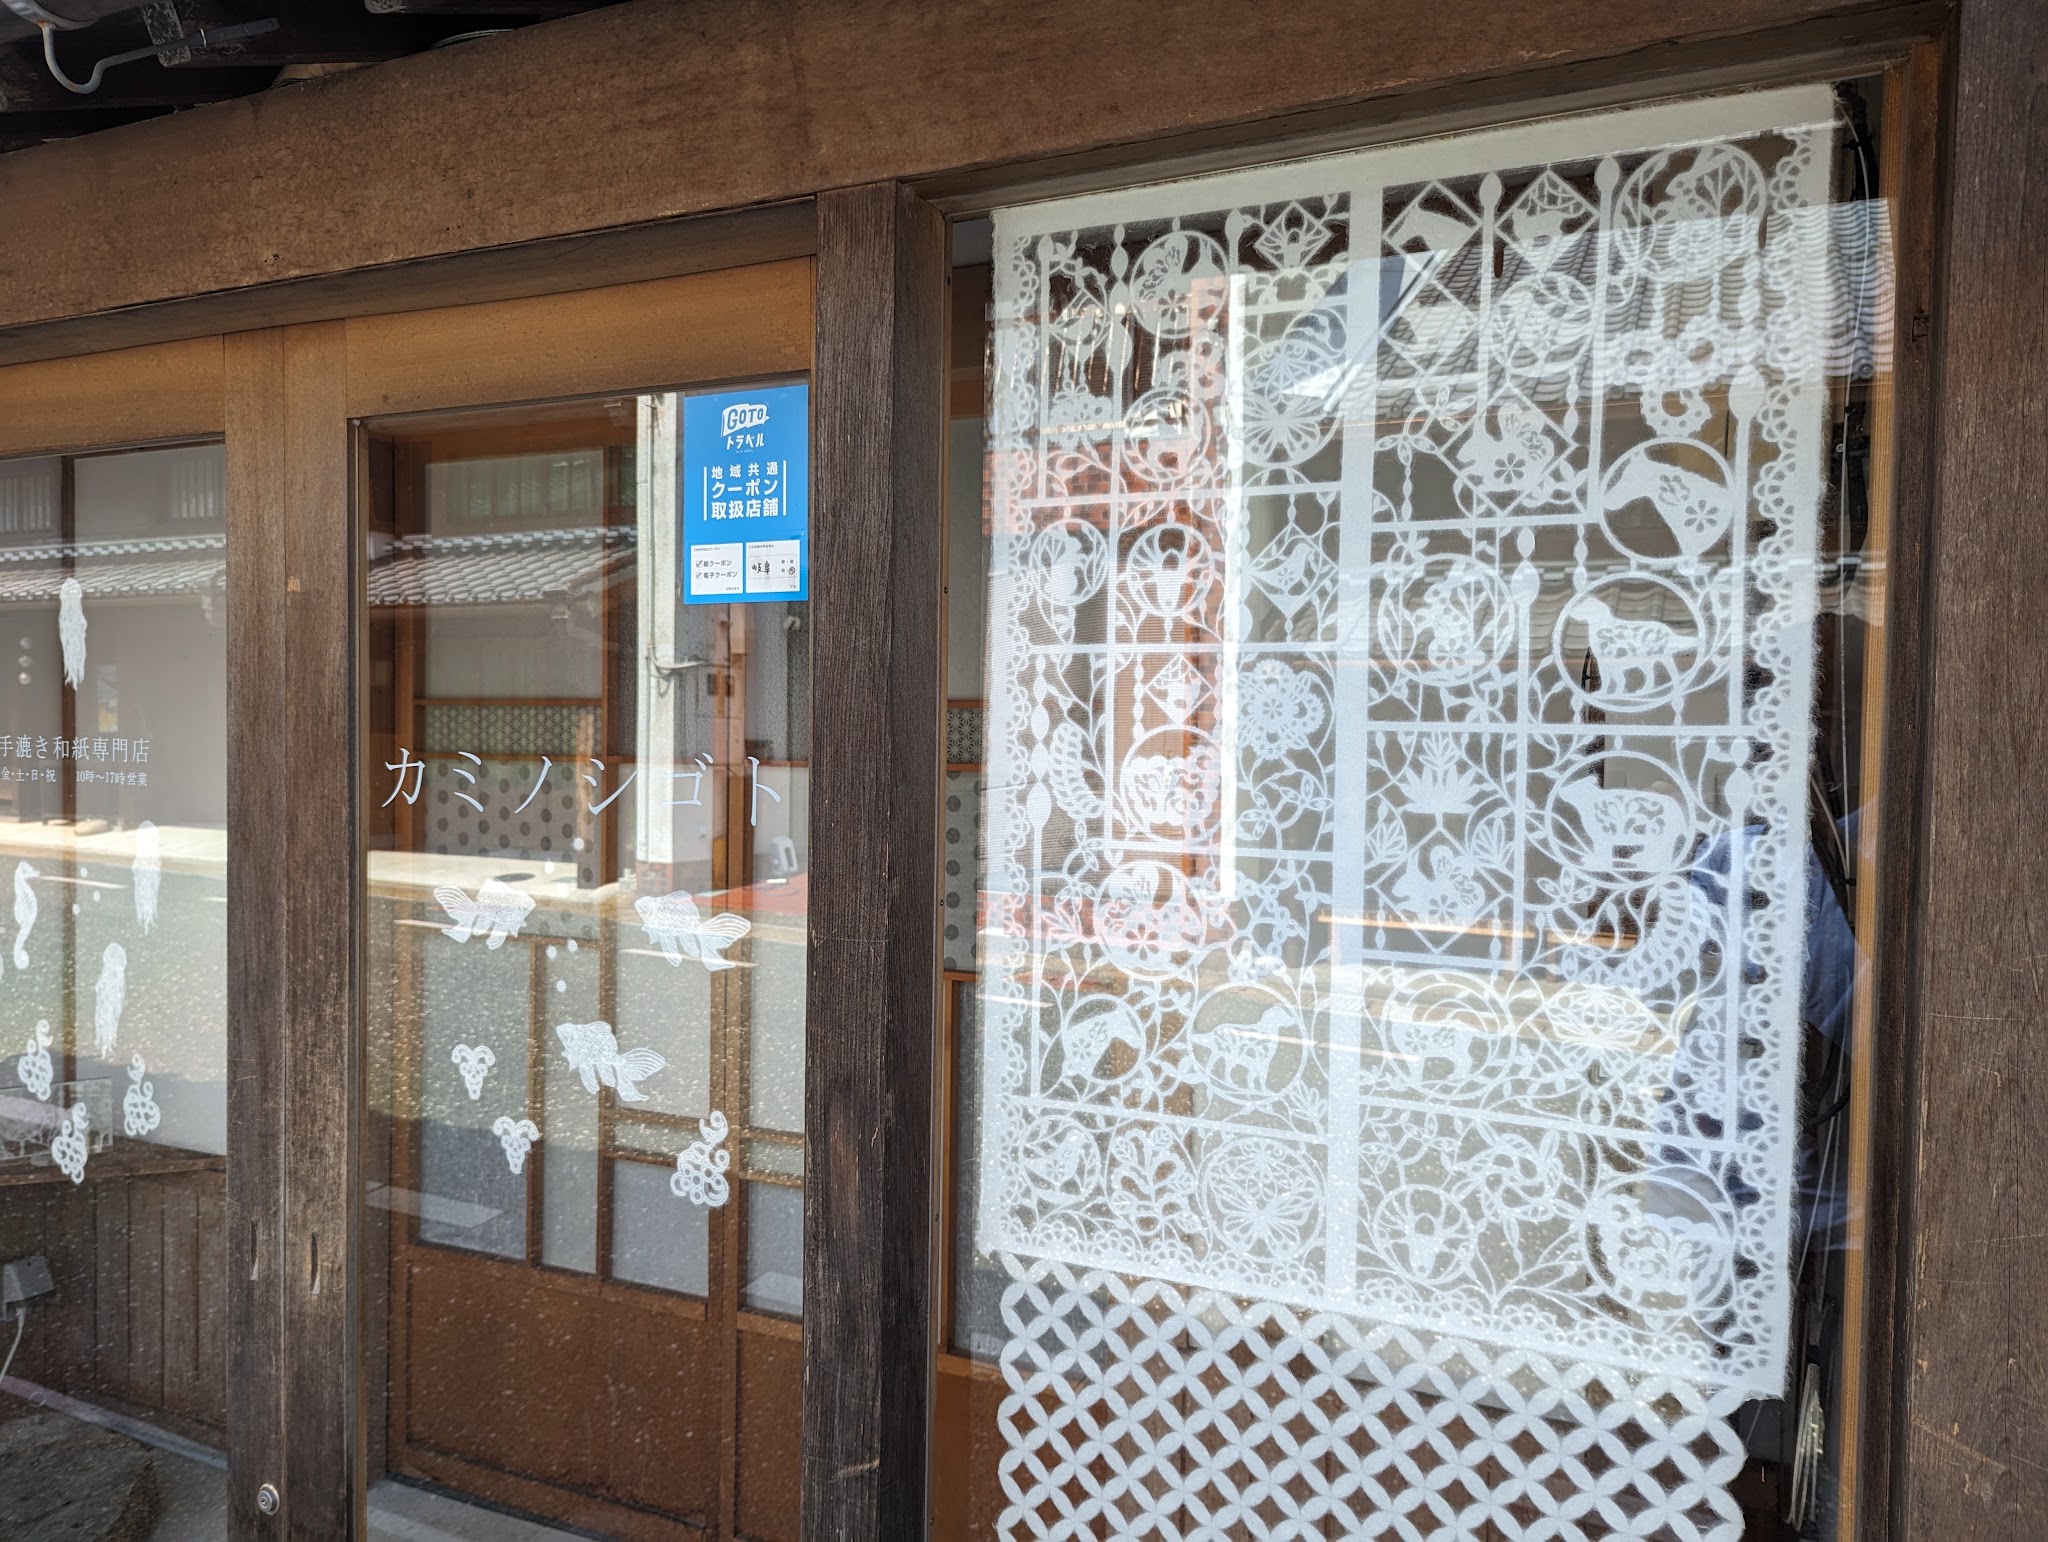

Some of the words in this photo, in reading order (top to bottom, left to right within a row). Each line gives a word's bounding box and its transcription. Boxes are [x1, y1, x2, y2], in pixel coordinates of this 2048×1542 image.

[726, 433, 765, 450] トラベル
[711, 462, 779, 479] 地域共通
[712, 479, 779, 499] クーポン
[711, 498, 779, 520] 取扱店舗
[703, 571, 738, 579] 電子クーポン
[0, 734, 150, 764] 手漉き和紙専門店
[382, 747, 781, 827] カミノシゴト
